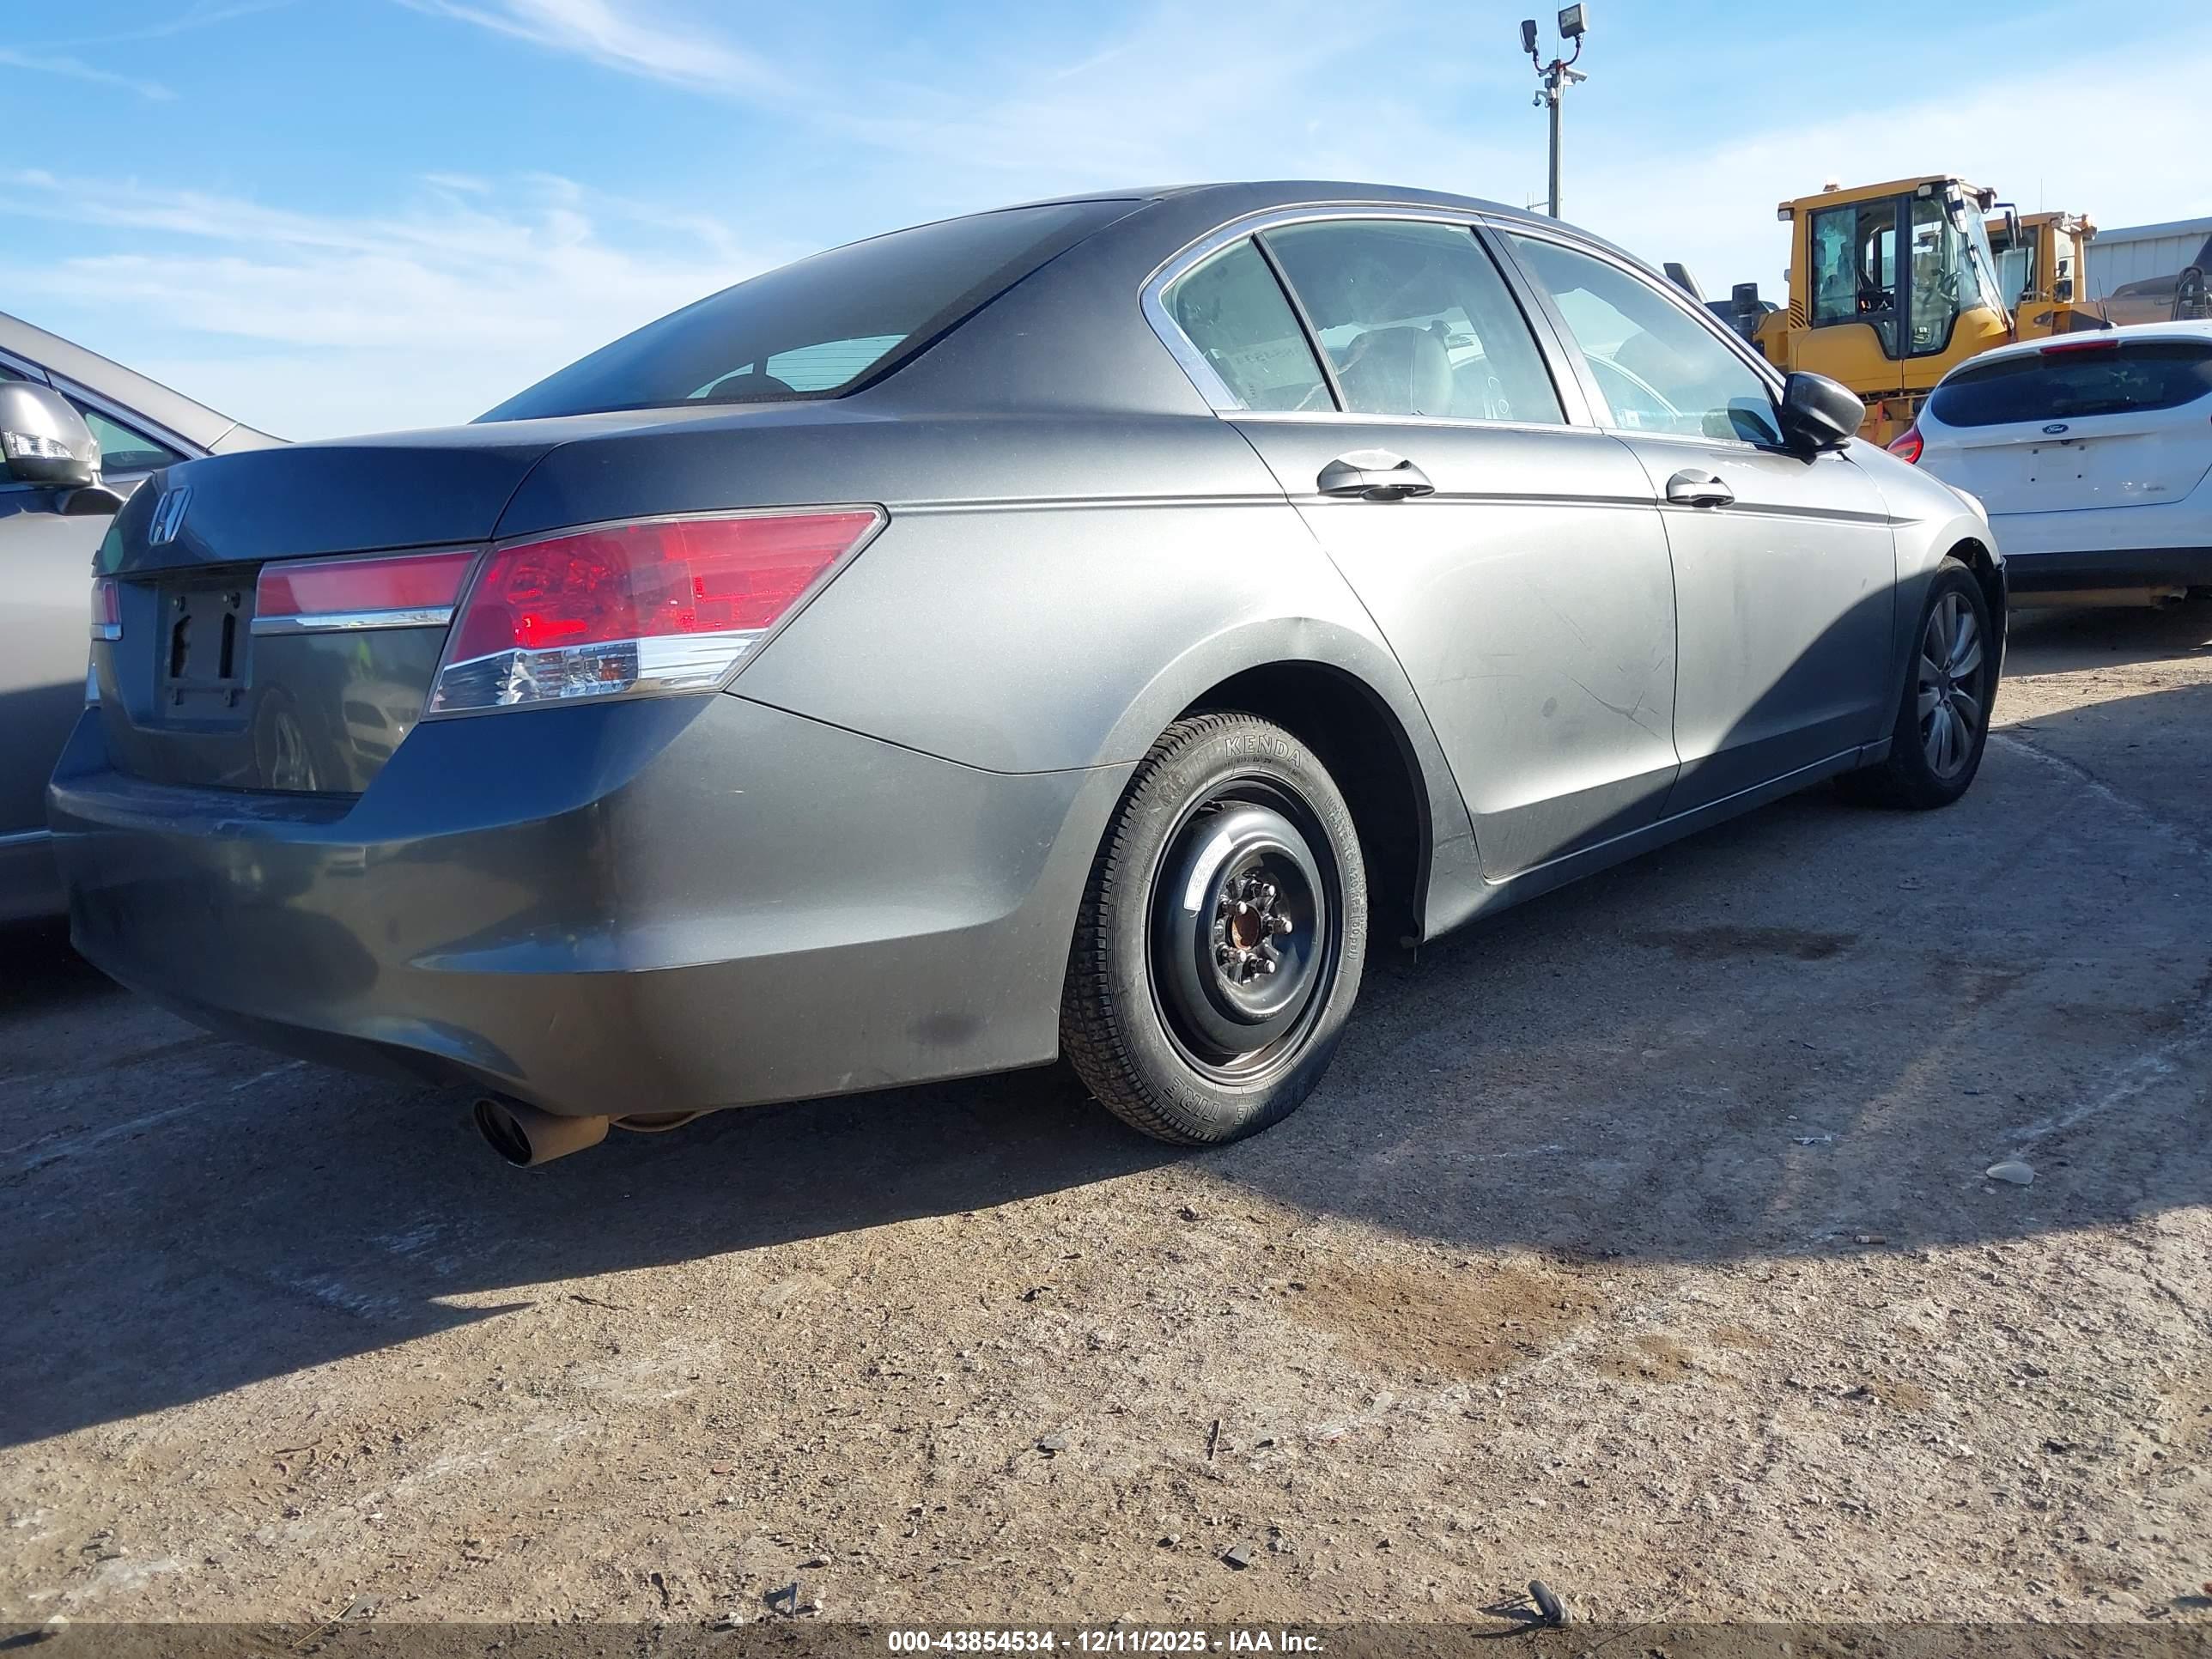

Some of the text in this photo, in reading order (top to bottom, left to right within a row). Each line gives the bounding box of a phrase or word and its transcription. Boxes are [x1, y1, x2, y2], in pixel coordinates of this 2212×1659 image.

[2045, 425, 2066, 434] Ford
[1224, 734, 1301, 769] KENDA
[1164, 1076, 1220, 1124] TIRE
